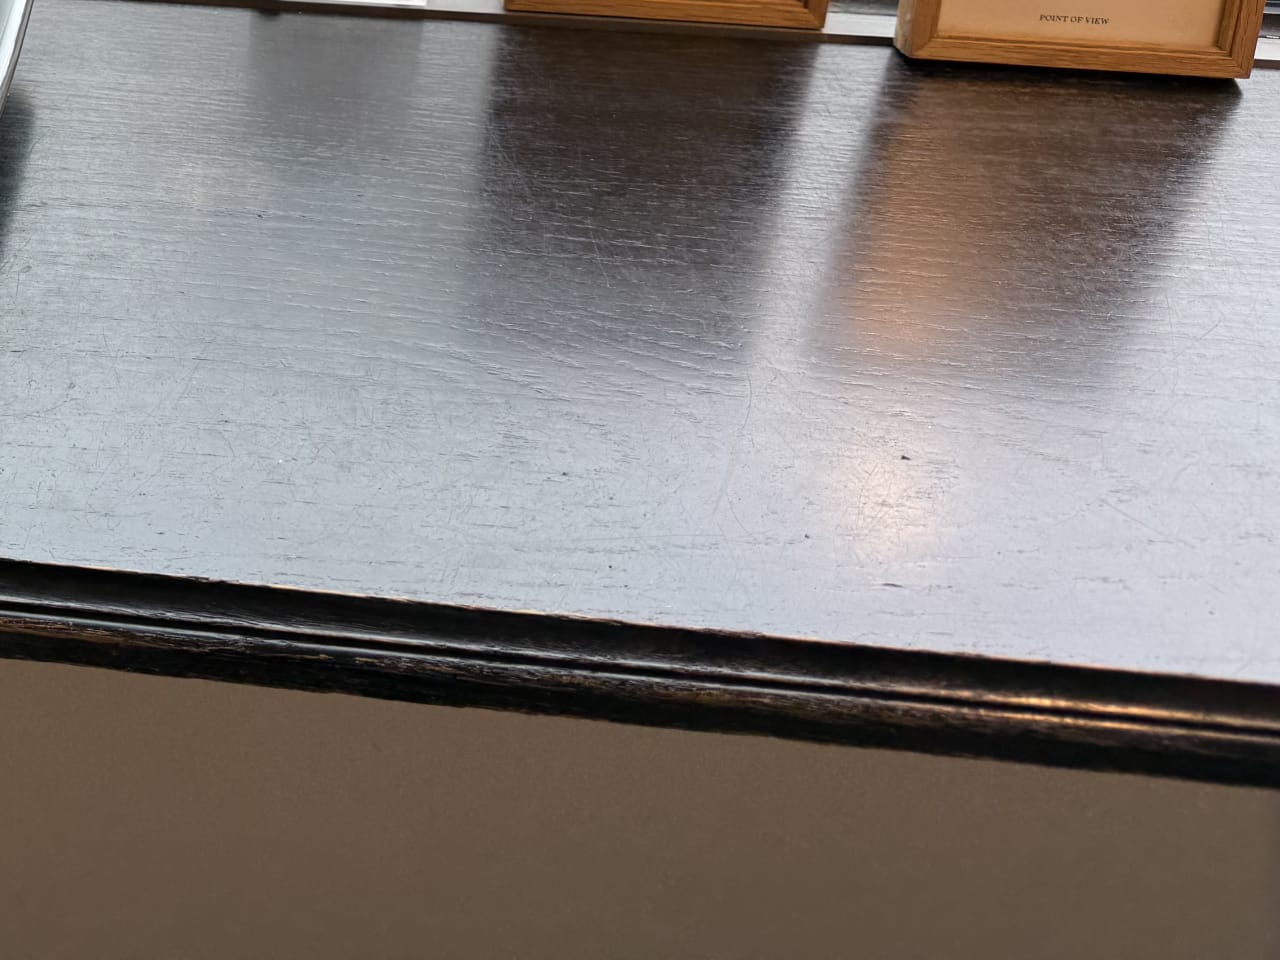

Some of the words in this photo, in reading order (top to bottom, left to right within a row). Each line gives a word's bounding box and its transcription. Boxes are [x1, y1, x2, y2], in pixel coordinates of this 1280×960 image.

[1039, 14, 1069, 23] POINT
[1070, 15, 1084, 24] OF
[1085, 16, 1109, 25] VIEW
